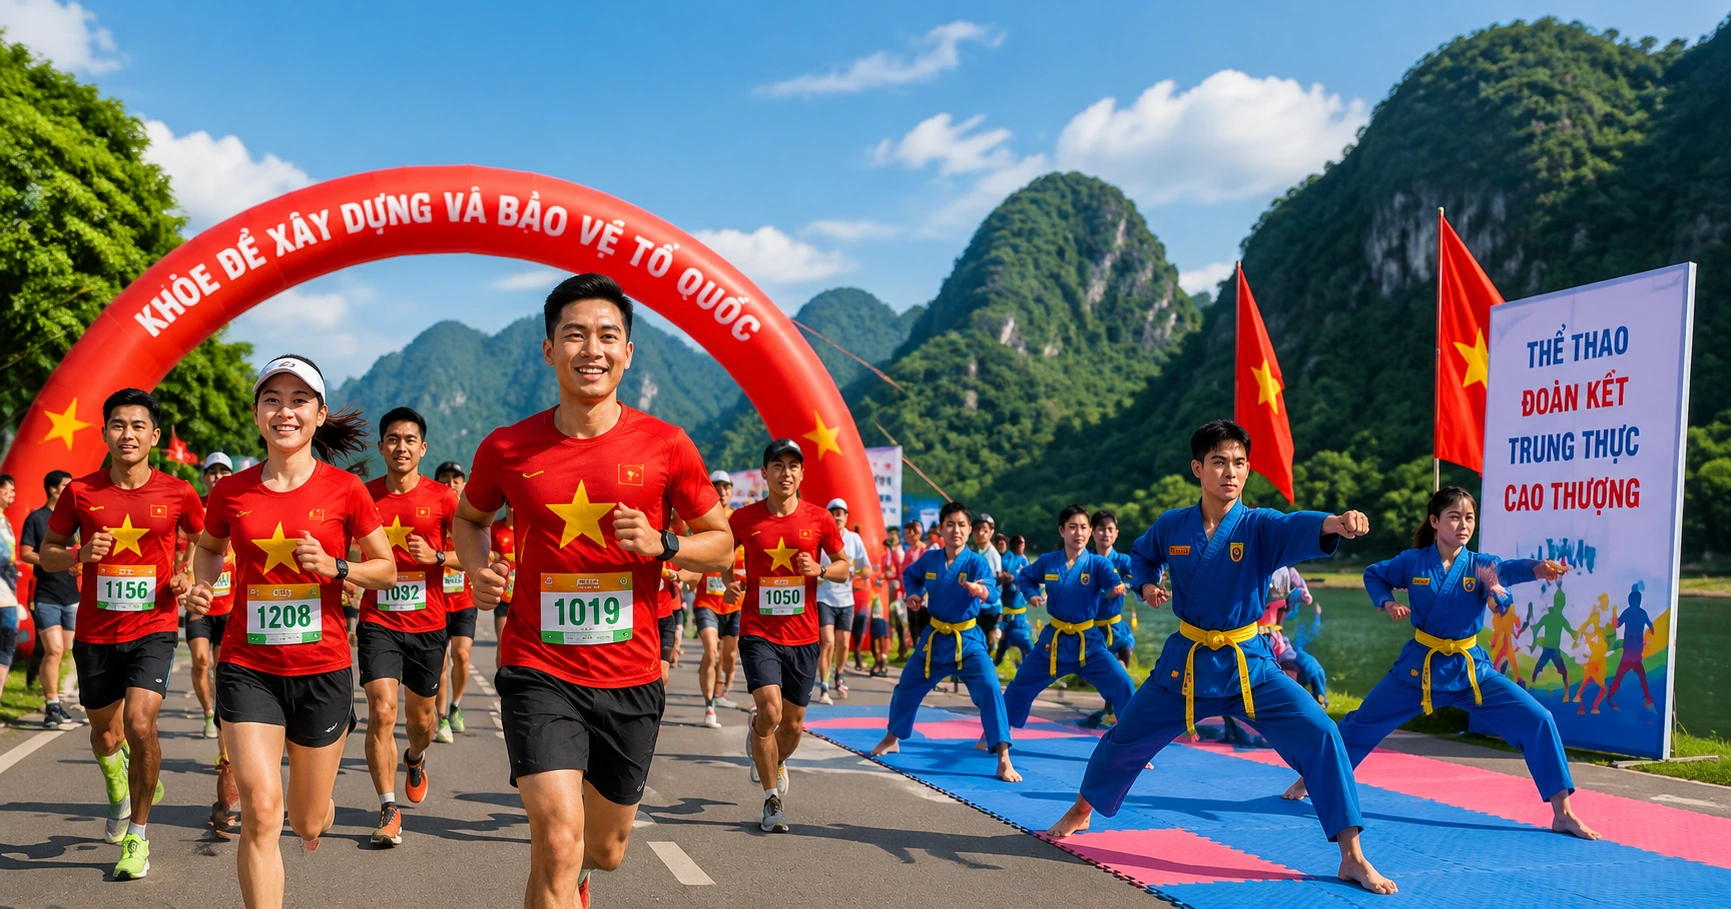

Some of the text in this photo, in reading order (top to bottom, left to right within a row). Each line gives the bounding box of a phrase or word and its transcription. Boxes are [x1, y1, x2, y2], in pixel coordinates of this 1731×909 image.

[266, 209, 332, 257] XÂY
[340, 193, 432, 235] DỰNG
[580, 214, 625, 259] VỆ
[1527, 324, 1629, 368] THỂ THAO
[1508, 424, 1640, 464] TRUNG THỰC
[1504, 477, 1640, 516] CAO THƯỢNG
[106, 580, 147, 599] 1156
[766, 589, 800, 605] 1050
[257, 604, 311, 629] 1208
[554, 597, 620, 626] 1019
